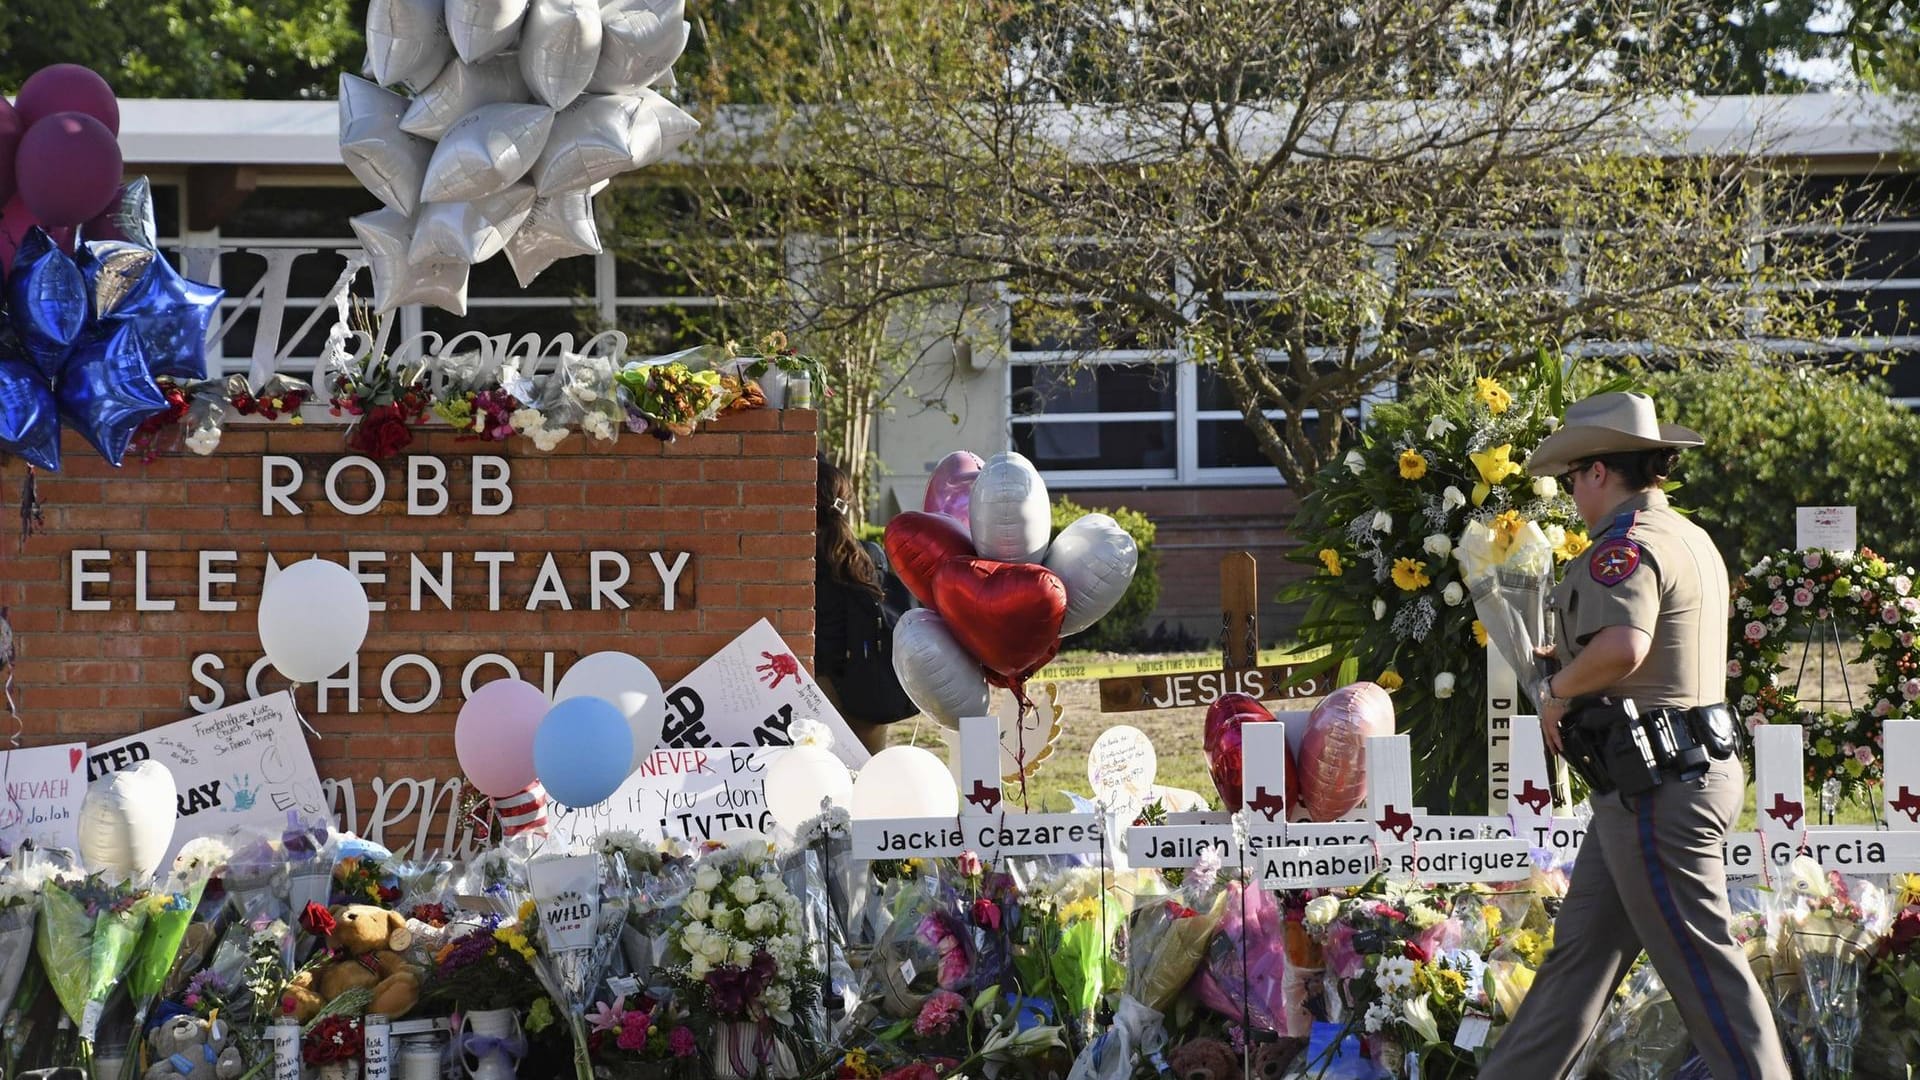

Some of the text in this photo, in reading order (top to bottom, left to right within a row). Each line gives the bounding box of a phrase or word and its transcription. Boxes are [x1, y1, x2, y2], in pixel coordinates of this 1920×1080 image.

[179, 247, 629, 400] Welcome
[262, 455, 514, 516] ROBB
[71, 550, 690, 612] ELEENTARY
[1153, 670, 1265, 708] JESUS
[88, 741, 150, 783] ITED
[640, 750, 765, 777] NEVER be
[1492, 699, 1511, 800] DEL RIO
[8, 779, 69, 802] NEVAEH
[176, 780, 221, 819] RAY
[628, 787, 648, 812] if
[656, 787, 698, 816] you
[715, 779, 768, 810] don't
[27, 805, 70, 824] Jailah
[877, 823, 1102, 852] Jackie Cazares
[1145, 835, 1229, 859] Jailah
[1533, 827, 1585, 849] Tor
[1264, 851, 1529, 880] Annabelle Rodriguez
[1722, 839, 1886, 867] ie Garcia
[547, 903, 591, 926] WILD
